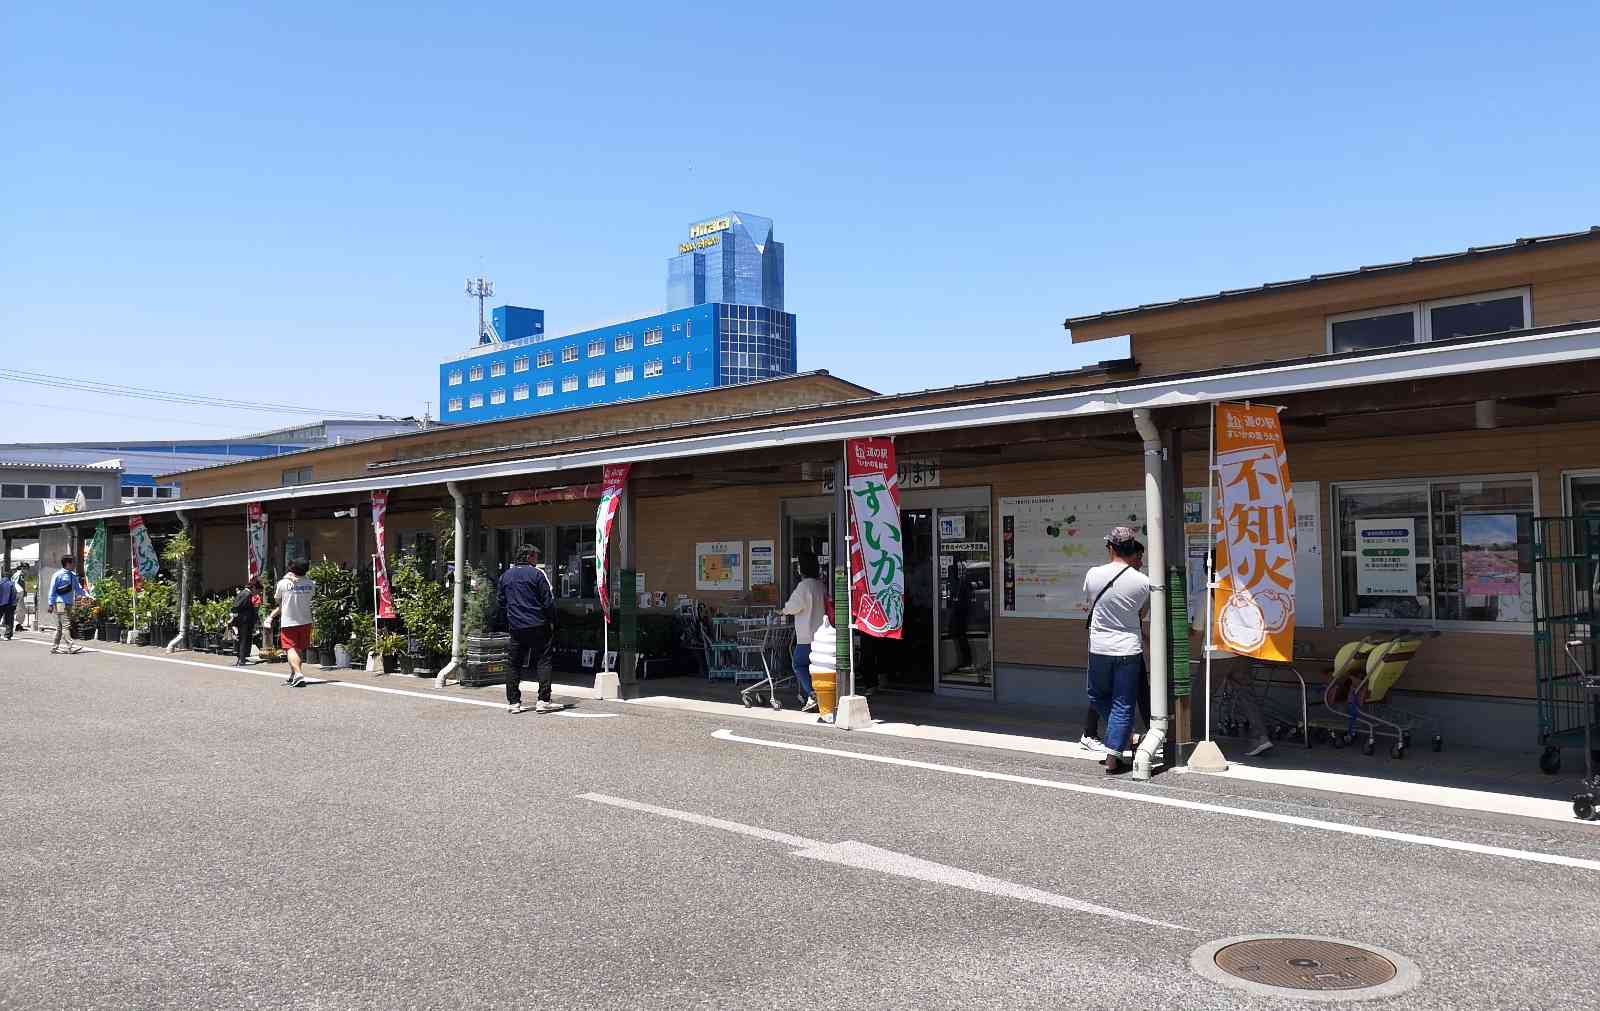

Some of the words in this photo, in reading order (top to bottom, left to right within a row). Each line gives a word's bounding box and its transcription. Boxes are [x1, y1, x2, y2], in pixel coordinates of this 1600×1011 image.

[690, 216, 730, 239] Hirata
[853, 481, 902, 586] すいか
[1226, 453, 1294, 590] 不知火
